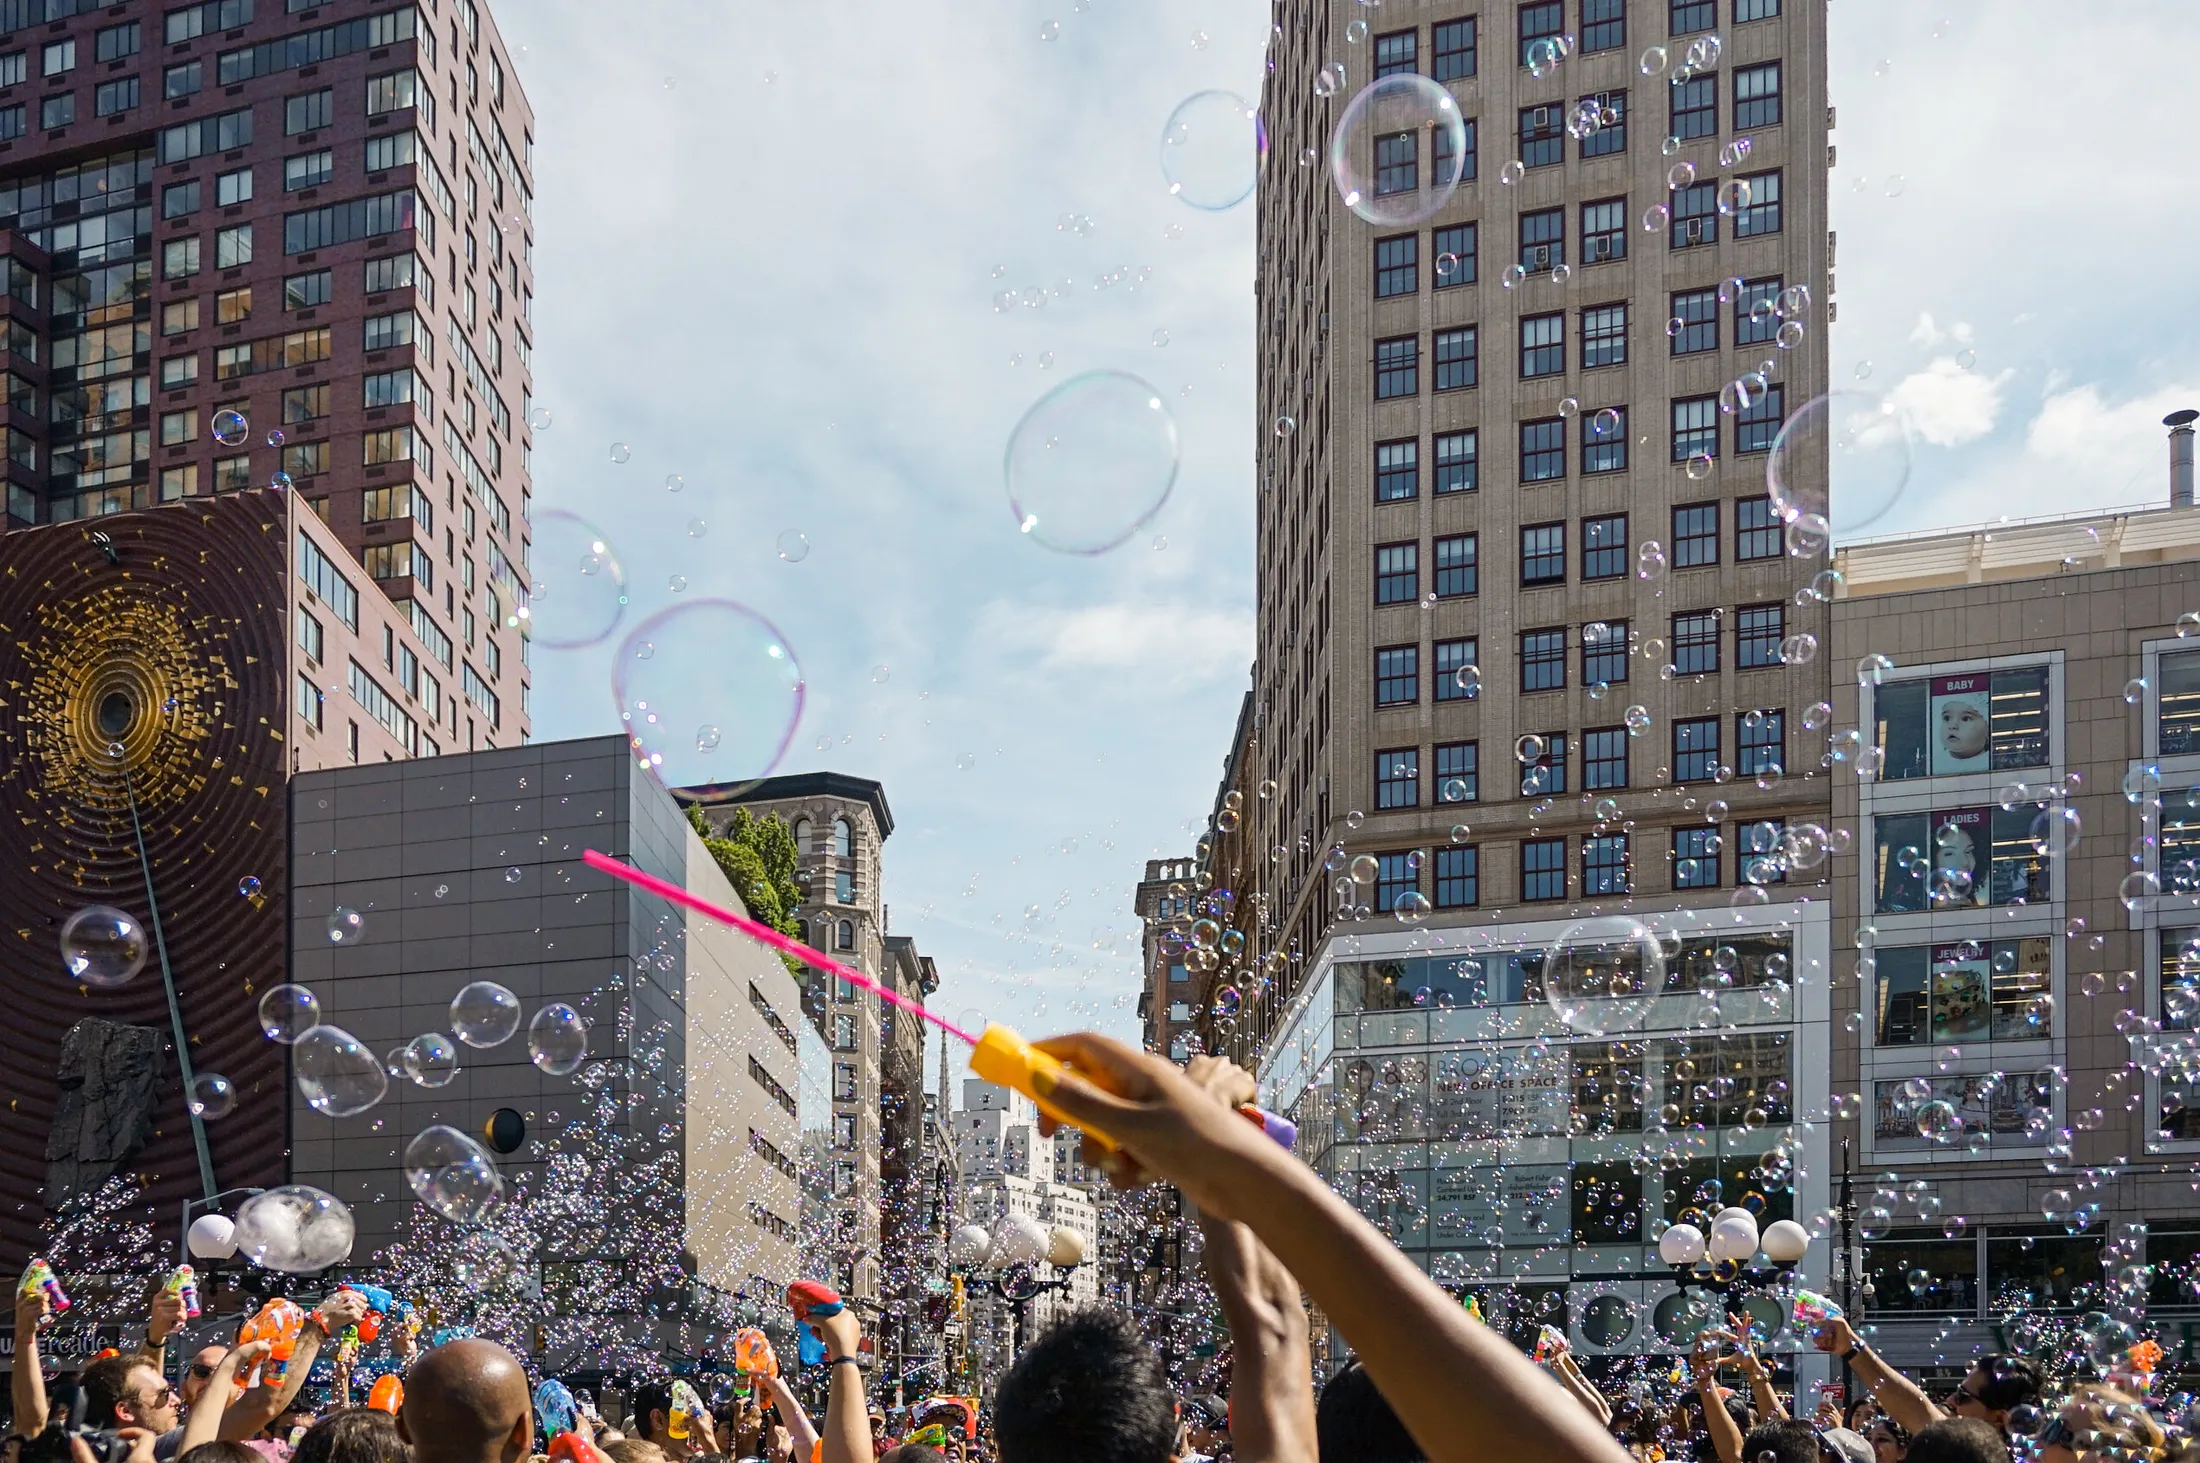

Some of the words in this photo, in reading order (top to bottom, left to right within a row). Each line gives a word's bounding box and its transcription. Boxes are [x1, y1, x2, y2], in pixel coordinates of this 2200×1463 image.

[1947, 679, 1974, 691] BABY
[1943, 813, 1980, 825] LADIES
[1937, 947, 1985, 960] JEWELRY
[1437, 1052, 1569, 1079] BROAD
[1437, 1082, 1467, 1093] NEW
[1471, 1079, 1515, 1091] OFFCE
[1520, 1077, 1557, 1089] SPACE
